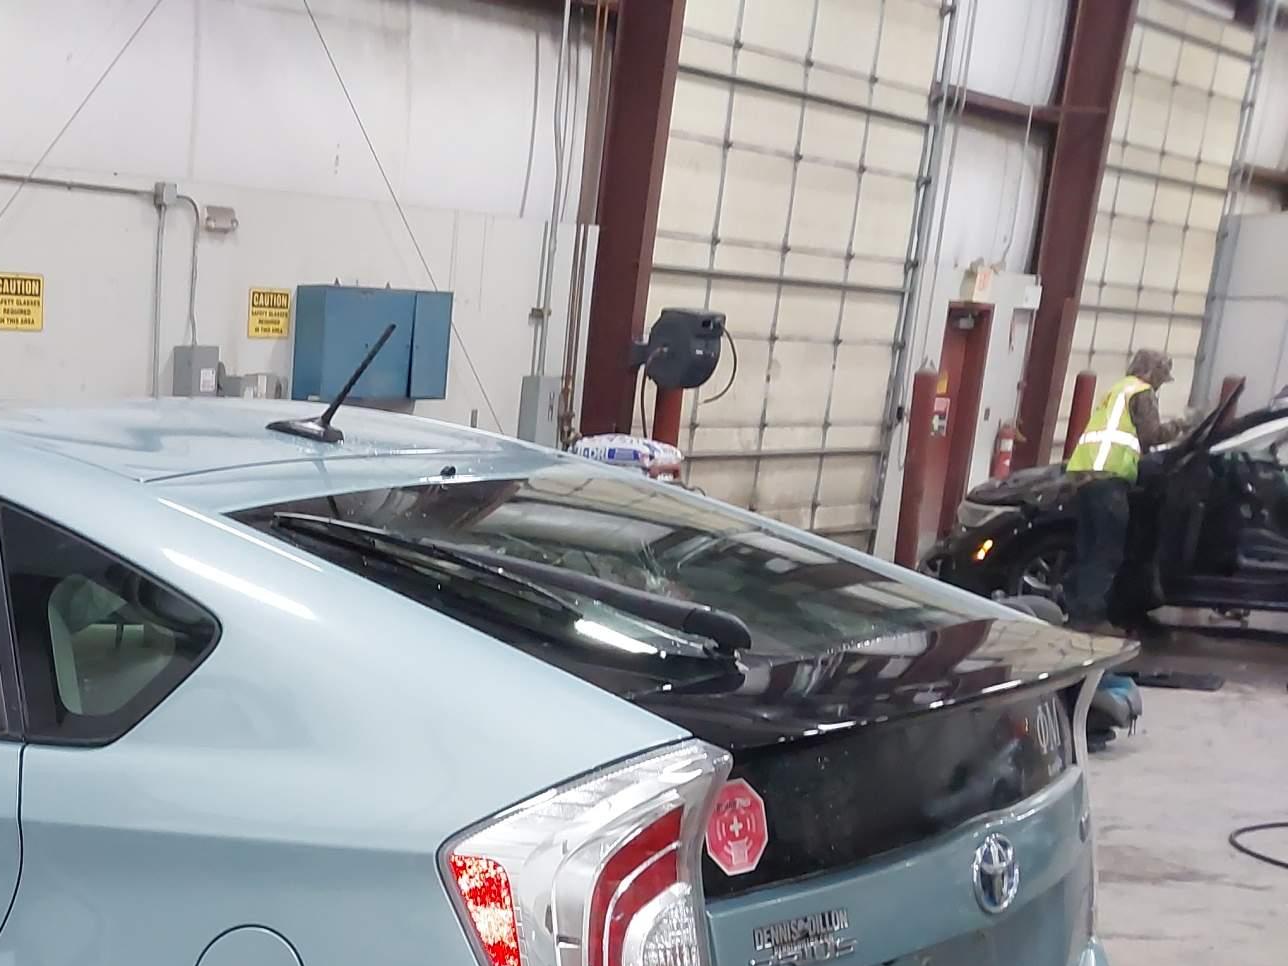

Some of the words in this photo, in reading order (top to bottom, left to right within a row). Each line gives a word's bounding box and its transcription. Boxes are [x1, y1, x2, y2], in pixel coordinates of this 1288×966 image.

[16, 299, 40, 307] GLASSES
[253, 293, 287, 308] CAUTION
[3, 308, 31, 316] REQUIRED
[20, 318, 35, 326] AREA
[754, 922, 798, 950] DENNIS
[808, 908, 849, 935] DILLON
